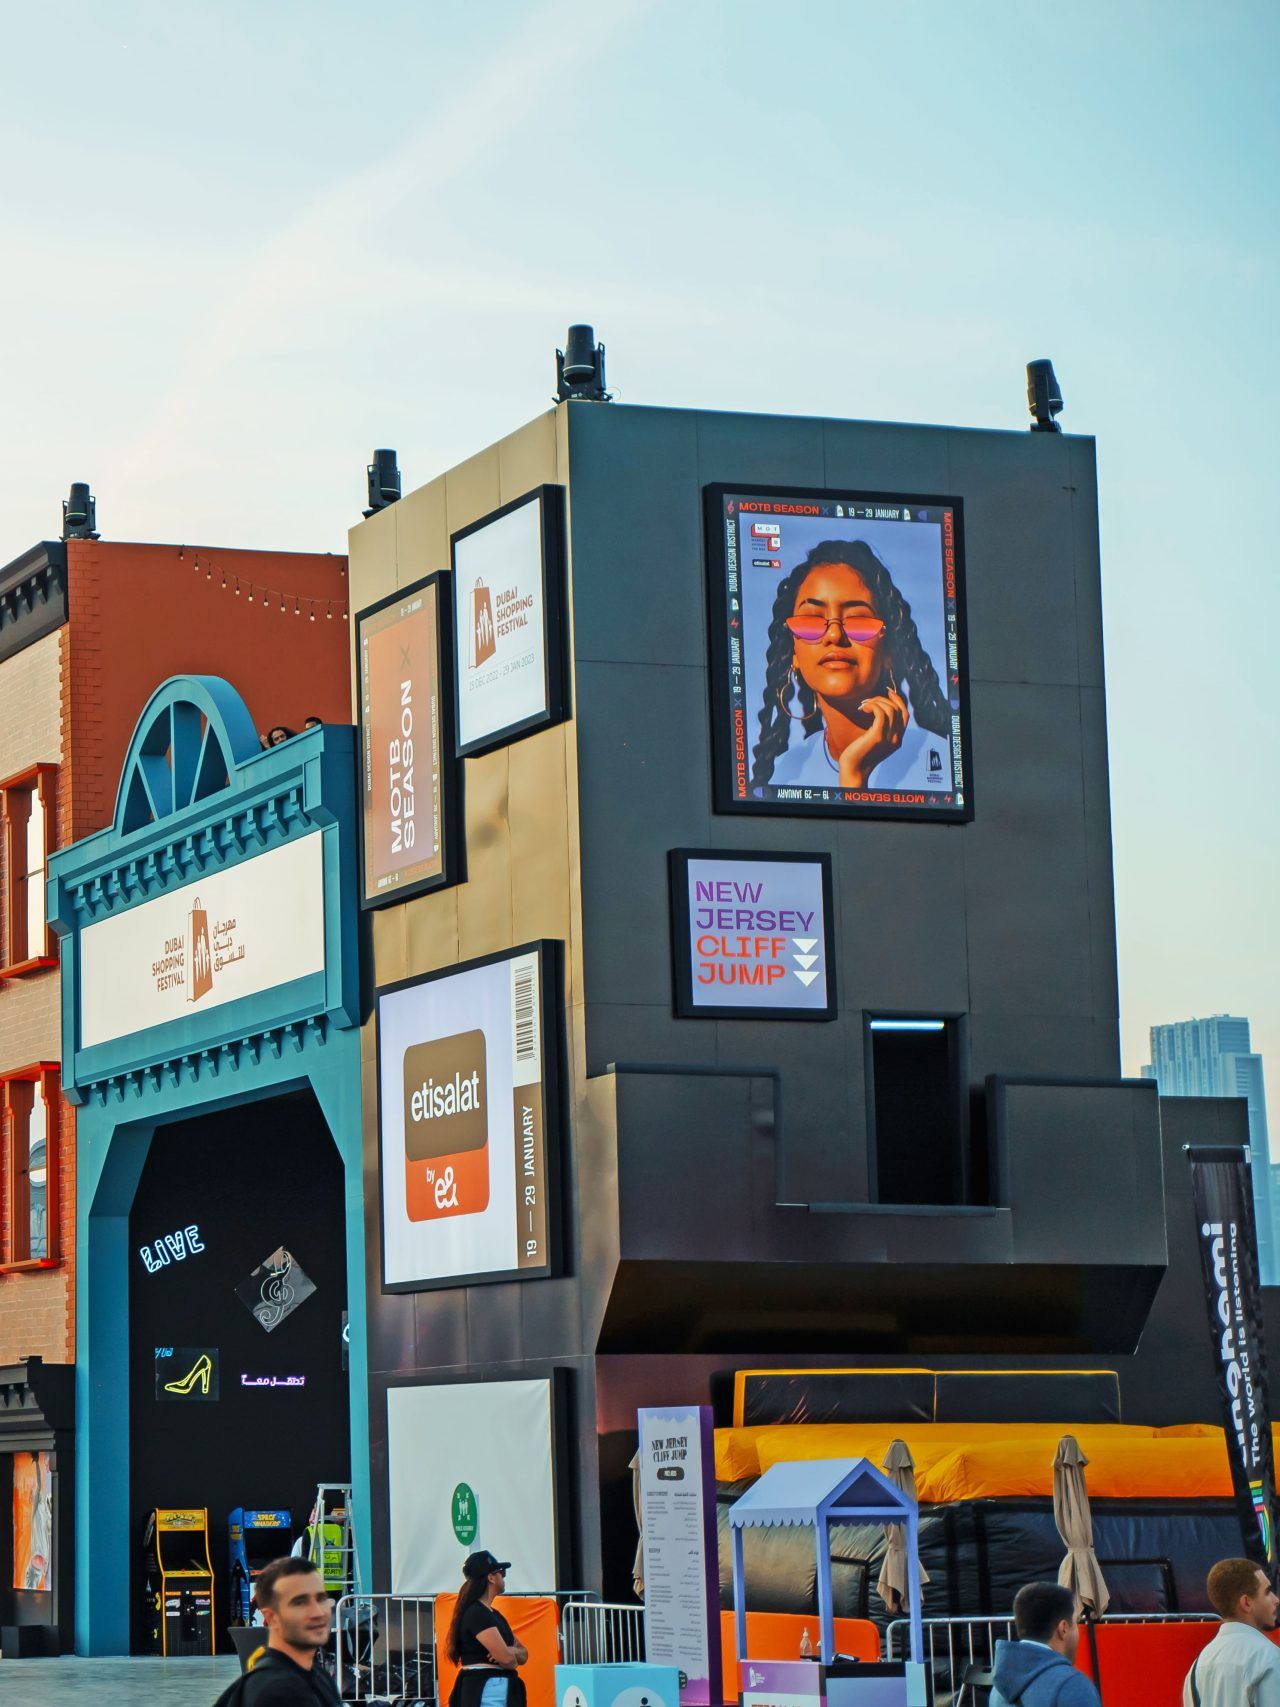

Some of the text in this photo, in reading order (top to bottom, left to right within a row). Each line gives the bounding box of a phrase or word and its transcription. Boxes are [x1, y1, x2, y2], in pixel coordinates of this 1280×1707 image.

[739, 502, 771, 512] MOTB
[773, 504, 820, 515] SEASON
[865, 508, 873, 518] 29
[875, 508, 900, 520] JANUARY
[943, 512, 953, 546] MOTB
[726, 518, 738, 592] DUBAI DESIGN DISTRICT
[945, 549, 955, 598] SEASON
[496, 586, 518, 608] DUBAI
[496, 594, 533, 623] SHOPPING
[497, 613, 528, 638] FESTIVAL
[731, 637, 741, 665] JANUARY
[947, 643, 958, 670] JANUARY
[735, 709, 744, 759] SEASON
[951, 715, 963, 788] DUBAI DESIGN DISTRICT
[400, 679, 415, 849] SEASON
[737, 762, 746, 798] MOTB
[389, 738, 402, 854] MOTB
[777, 788, 802, 799] JANUARY
[844, 792, 891, 803] SEASON
[893, 794, 925, 803] MOTB
[695, 880, 763, 903] NEW
[213, 919, 236, 939] مهرجان
[696, 908, 815, 932] JERSEY
[164, 935, 184, 955] DUBAI
[213, 937, 233, 951] دبي
[697, 935, 786, 958] CLIFF
[152, 953, 184, 976] SHOPPING
[697, 963, 786, 985] JUMP
[157, 971, 184, 992] FESTIVAL
[411, 1071, 480, 1122] etisalat
[524, 1105, 534, 1177] JANUARY
[426, 1167, 435, 1184] by
[525, 1185, 536, 1205] 29
[526, 1239, 537, 1257] 19
[1230, 1223, 1261, 1467] The world is listening
[651, 1436, 688, 1451] NEW JERSEY
[671, 1449, 687, 1461] JUMP
